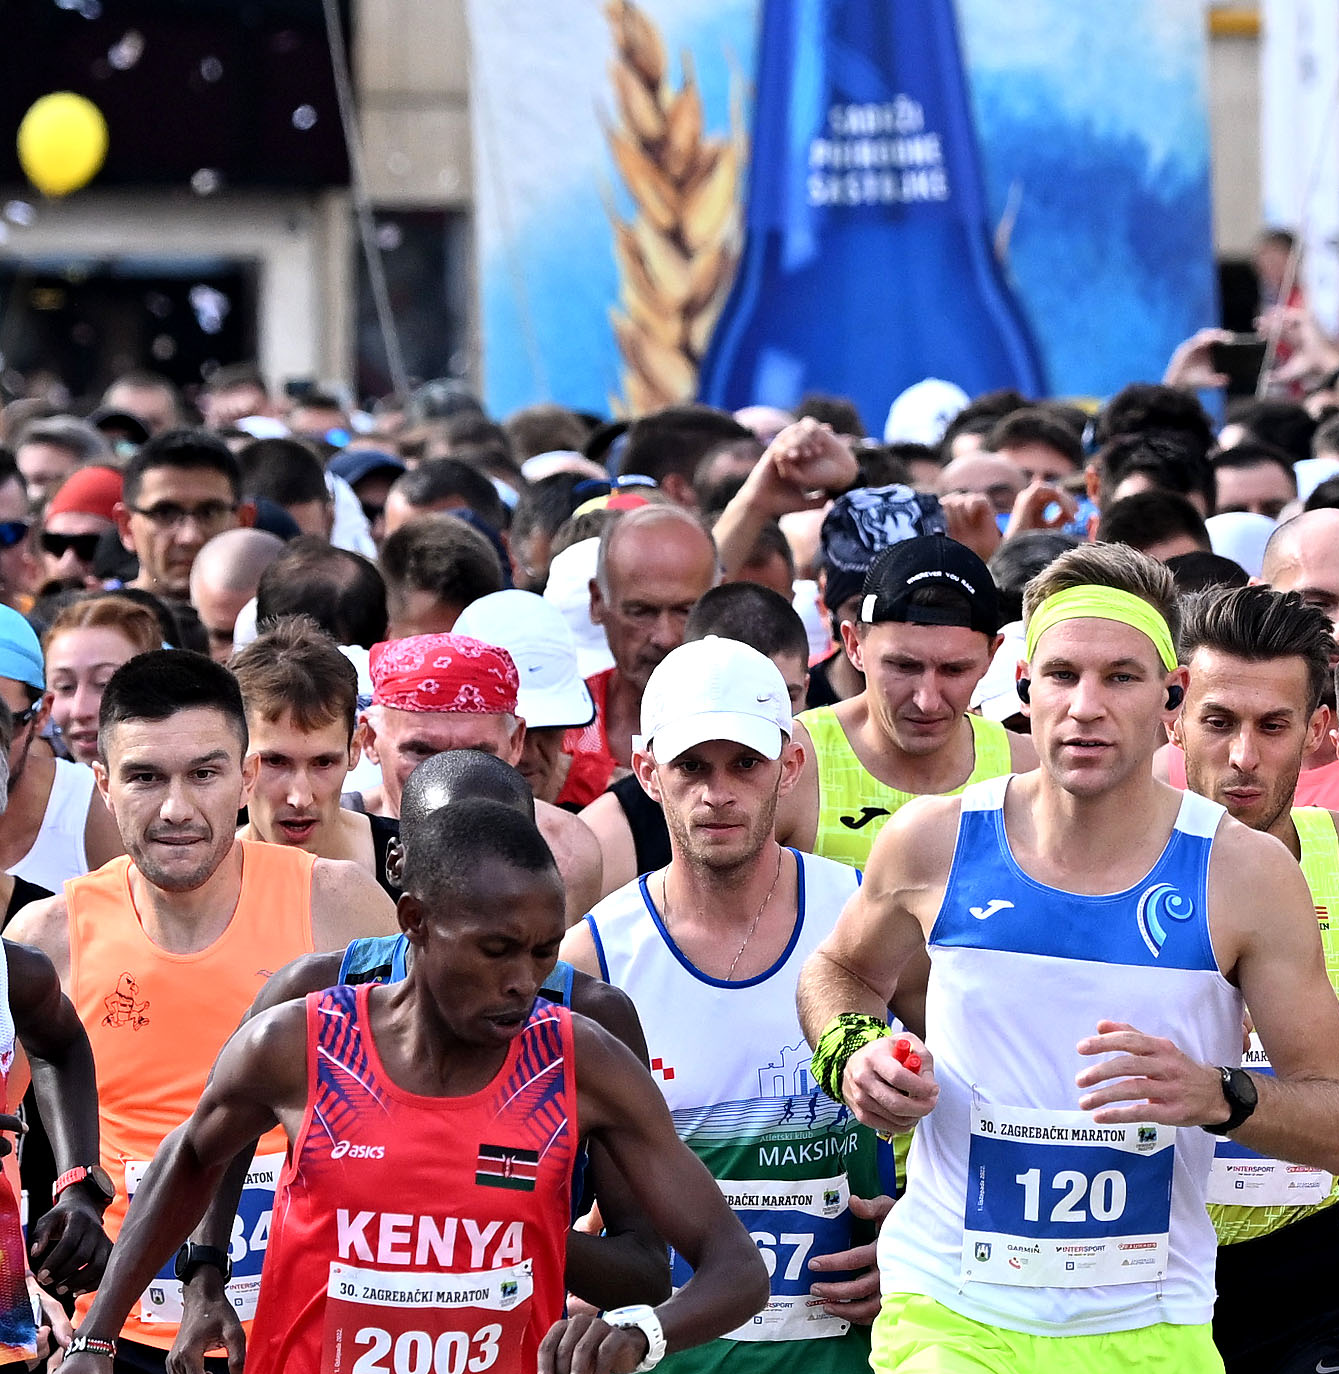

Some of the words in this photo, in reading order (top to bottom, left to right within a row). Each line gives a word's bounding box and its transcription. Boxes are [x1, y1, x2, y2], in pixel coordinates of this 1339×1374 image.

[945, 572, 959, 582] YOU
[961, 579, 976, 594] RACE
[760, 1132, 793, 1142] Atletski
[795, 1131, 814, 1140] klub
[980, 1119, 997, 1134] 30.
[1001, 1123, 1068, 1140] ZAGREBAČKI
[1071, 1129, 1126, 1142] MARATON
[341, 1141, 385, 1159] asics
[761, 1195, 813, 1206] MARATON
[1015, 1168, 1127, 1223] 120
[336, 1208, 524, 1269] KENYA
[1007, 1244, 1041, 1253] GARMIN
[1062, 1245, 1106, 1253] INTERSPORT
[340, 1282, 358, 1298] 30.
[362, 1286, 433, 1303] ZAGREBAČKI
[436, 1288, 490, 1303] MARATON
